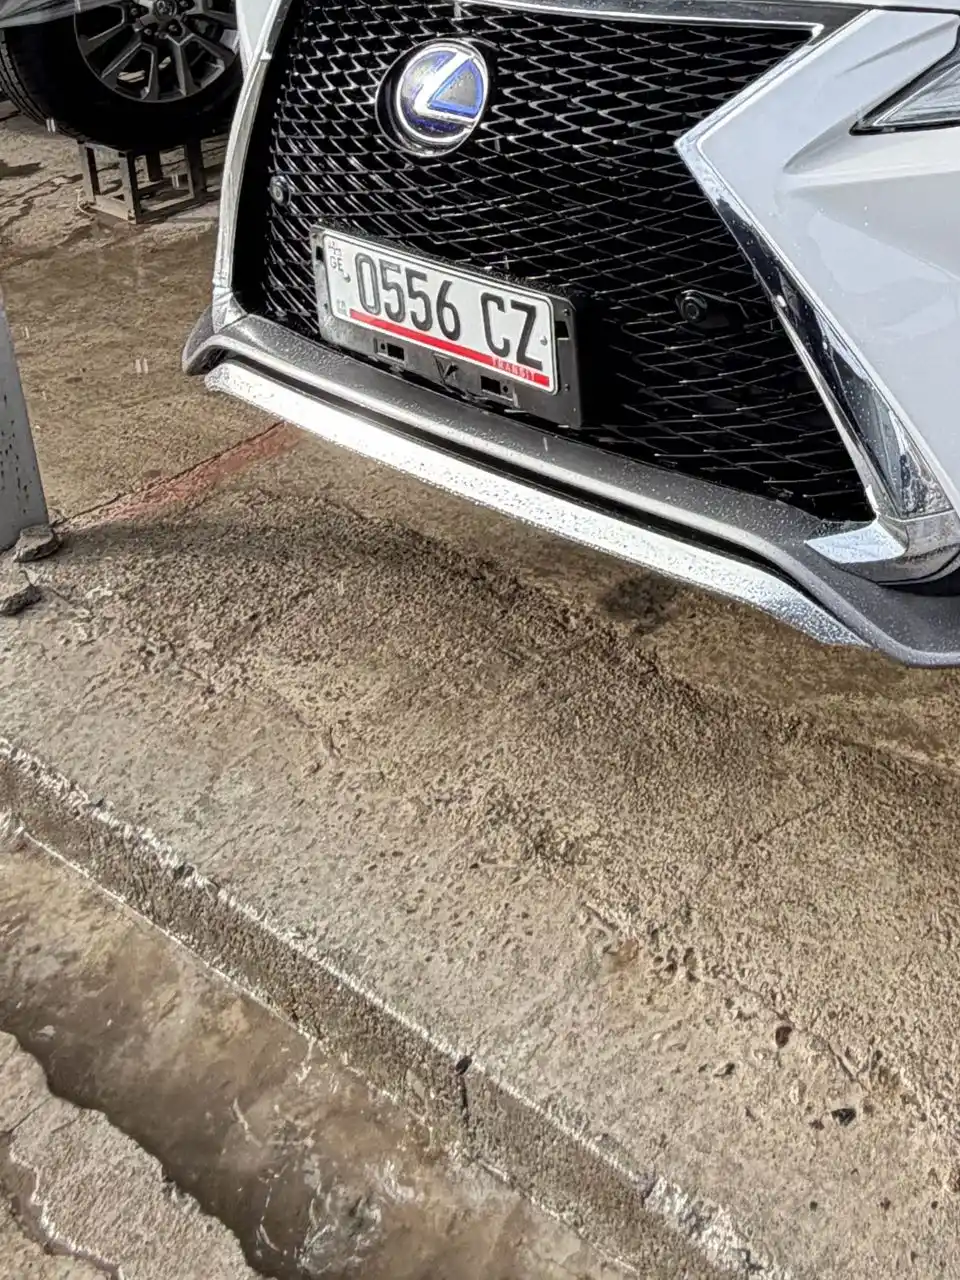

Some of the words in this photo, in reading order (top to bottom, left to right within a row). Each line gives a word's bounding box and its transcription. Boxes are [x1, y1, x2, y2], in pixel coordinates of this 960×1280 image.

[329, 256, 344, 272] GE
[354, 252, 461, 342] 0556
[480, 292, 543, 371] CZ
[491, 356, 536, 381] TRANSIT
